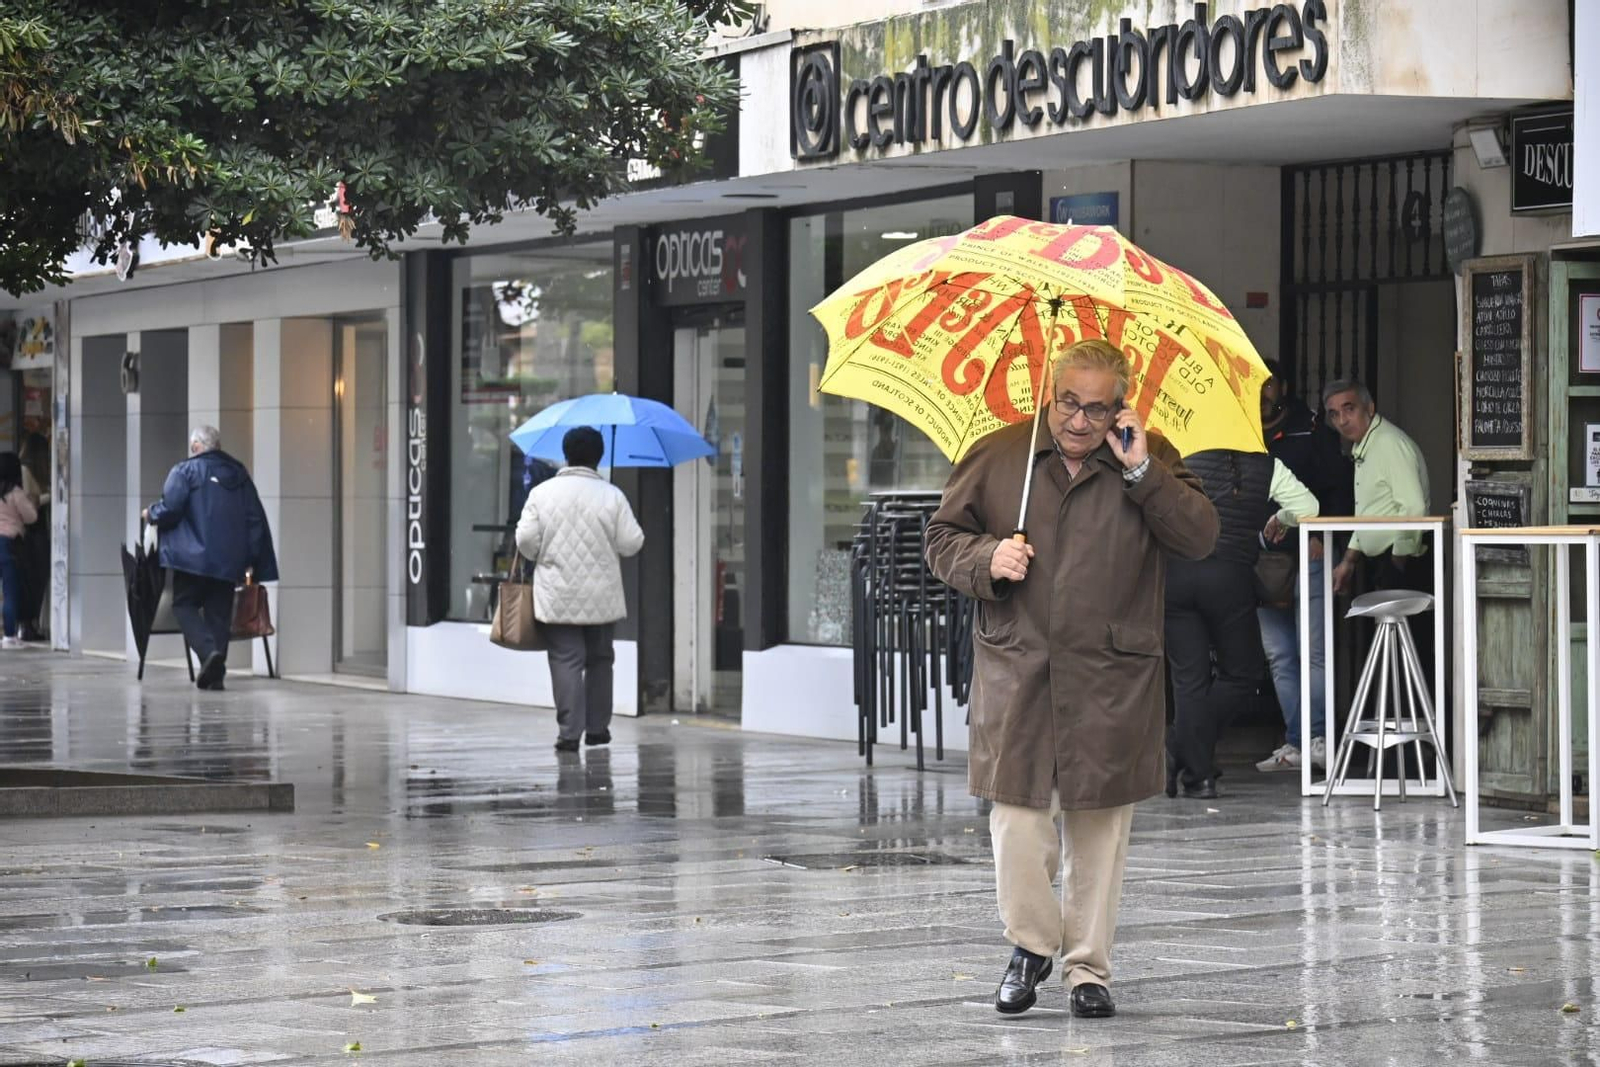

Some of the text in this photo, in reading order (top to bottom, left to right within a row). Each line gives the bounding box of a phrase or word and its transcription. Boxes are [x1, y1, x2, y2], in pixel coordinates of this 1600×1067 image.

[845, 0, 1328, 149] centro descubridores
[656, 229, 724, 294] opticas
[697, 278, 722, 297] center
[948, 254, 996, 269] PRODUCT
[409, 408, 425, 584] opticas
